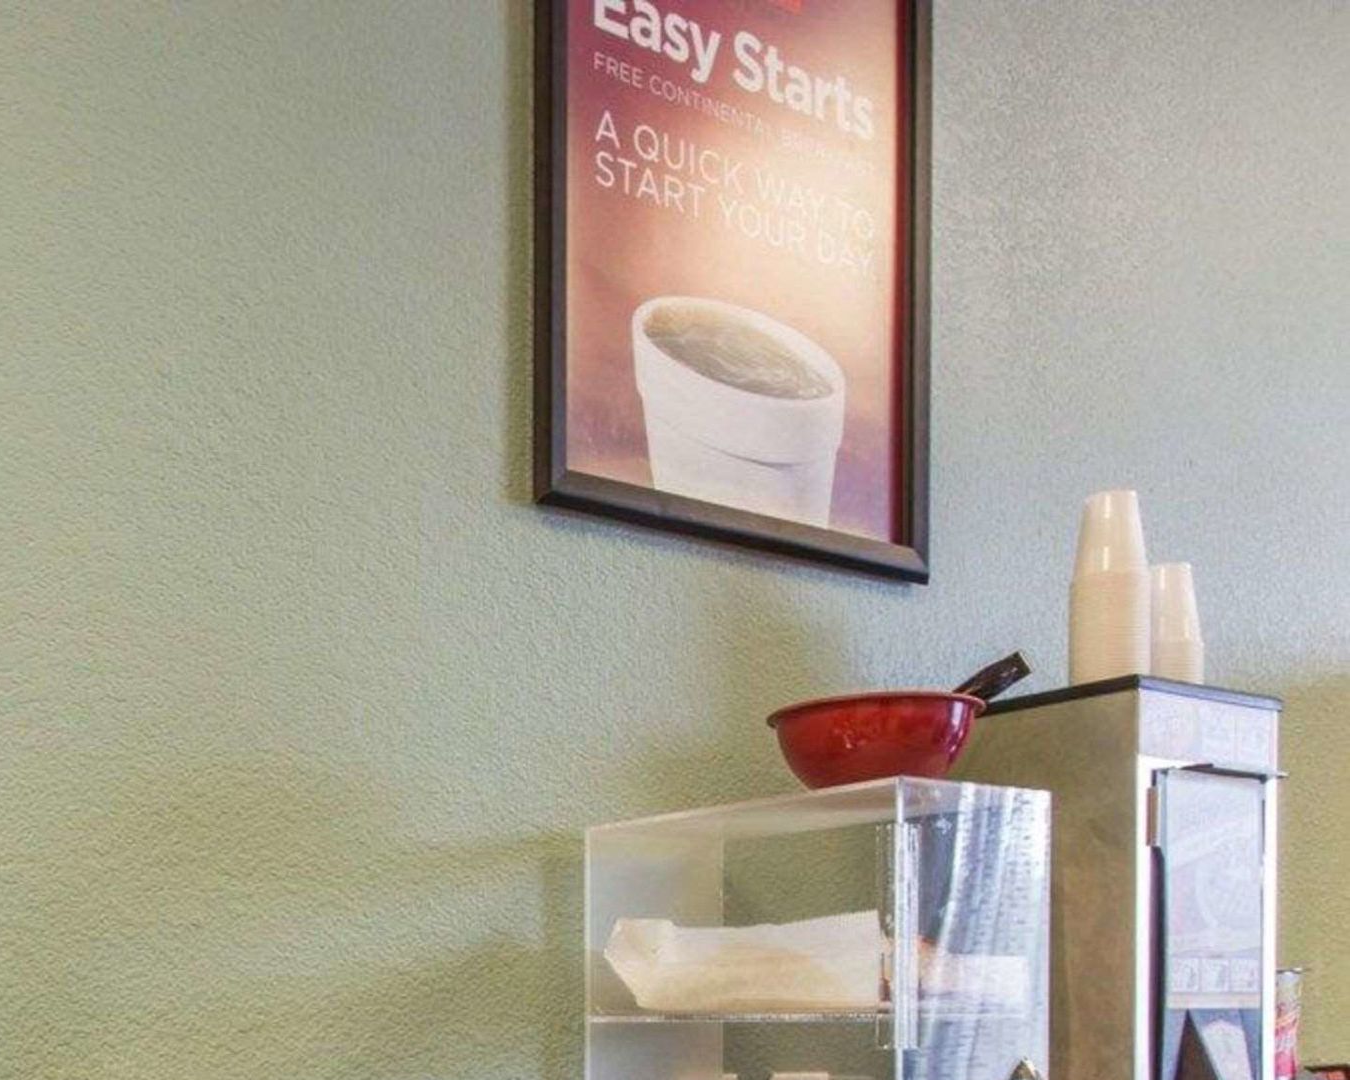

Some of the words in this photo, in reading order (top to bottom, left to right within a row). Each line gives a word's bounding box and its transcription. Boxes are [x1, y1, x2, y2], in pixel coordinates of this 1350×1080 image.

[593, 0, 721, 83] Easy
[732, 31, 874, 140] Starts
[593, 51, 643, 89] FREE
[595, 109, 620, 150] A
[633, 125, 745, 195] QUICK
[754, 166, 826, 227] WAY
[595, 151, 705, 218] START
[717, 193, 806, 253] YOUR
